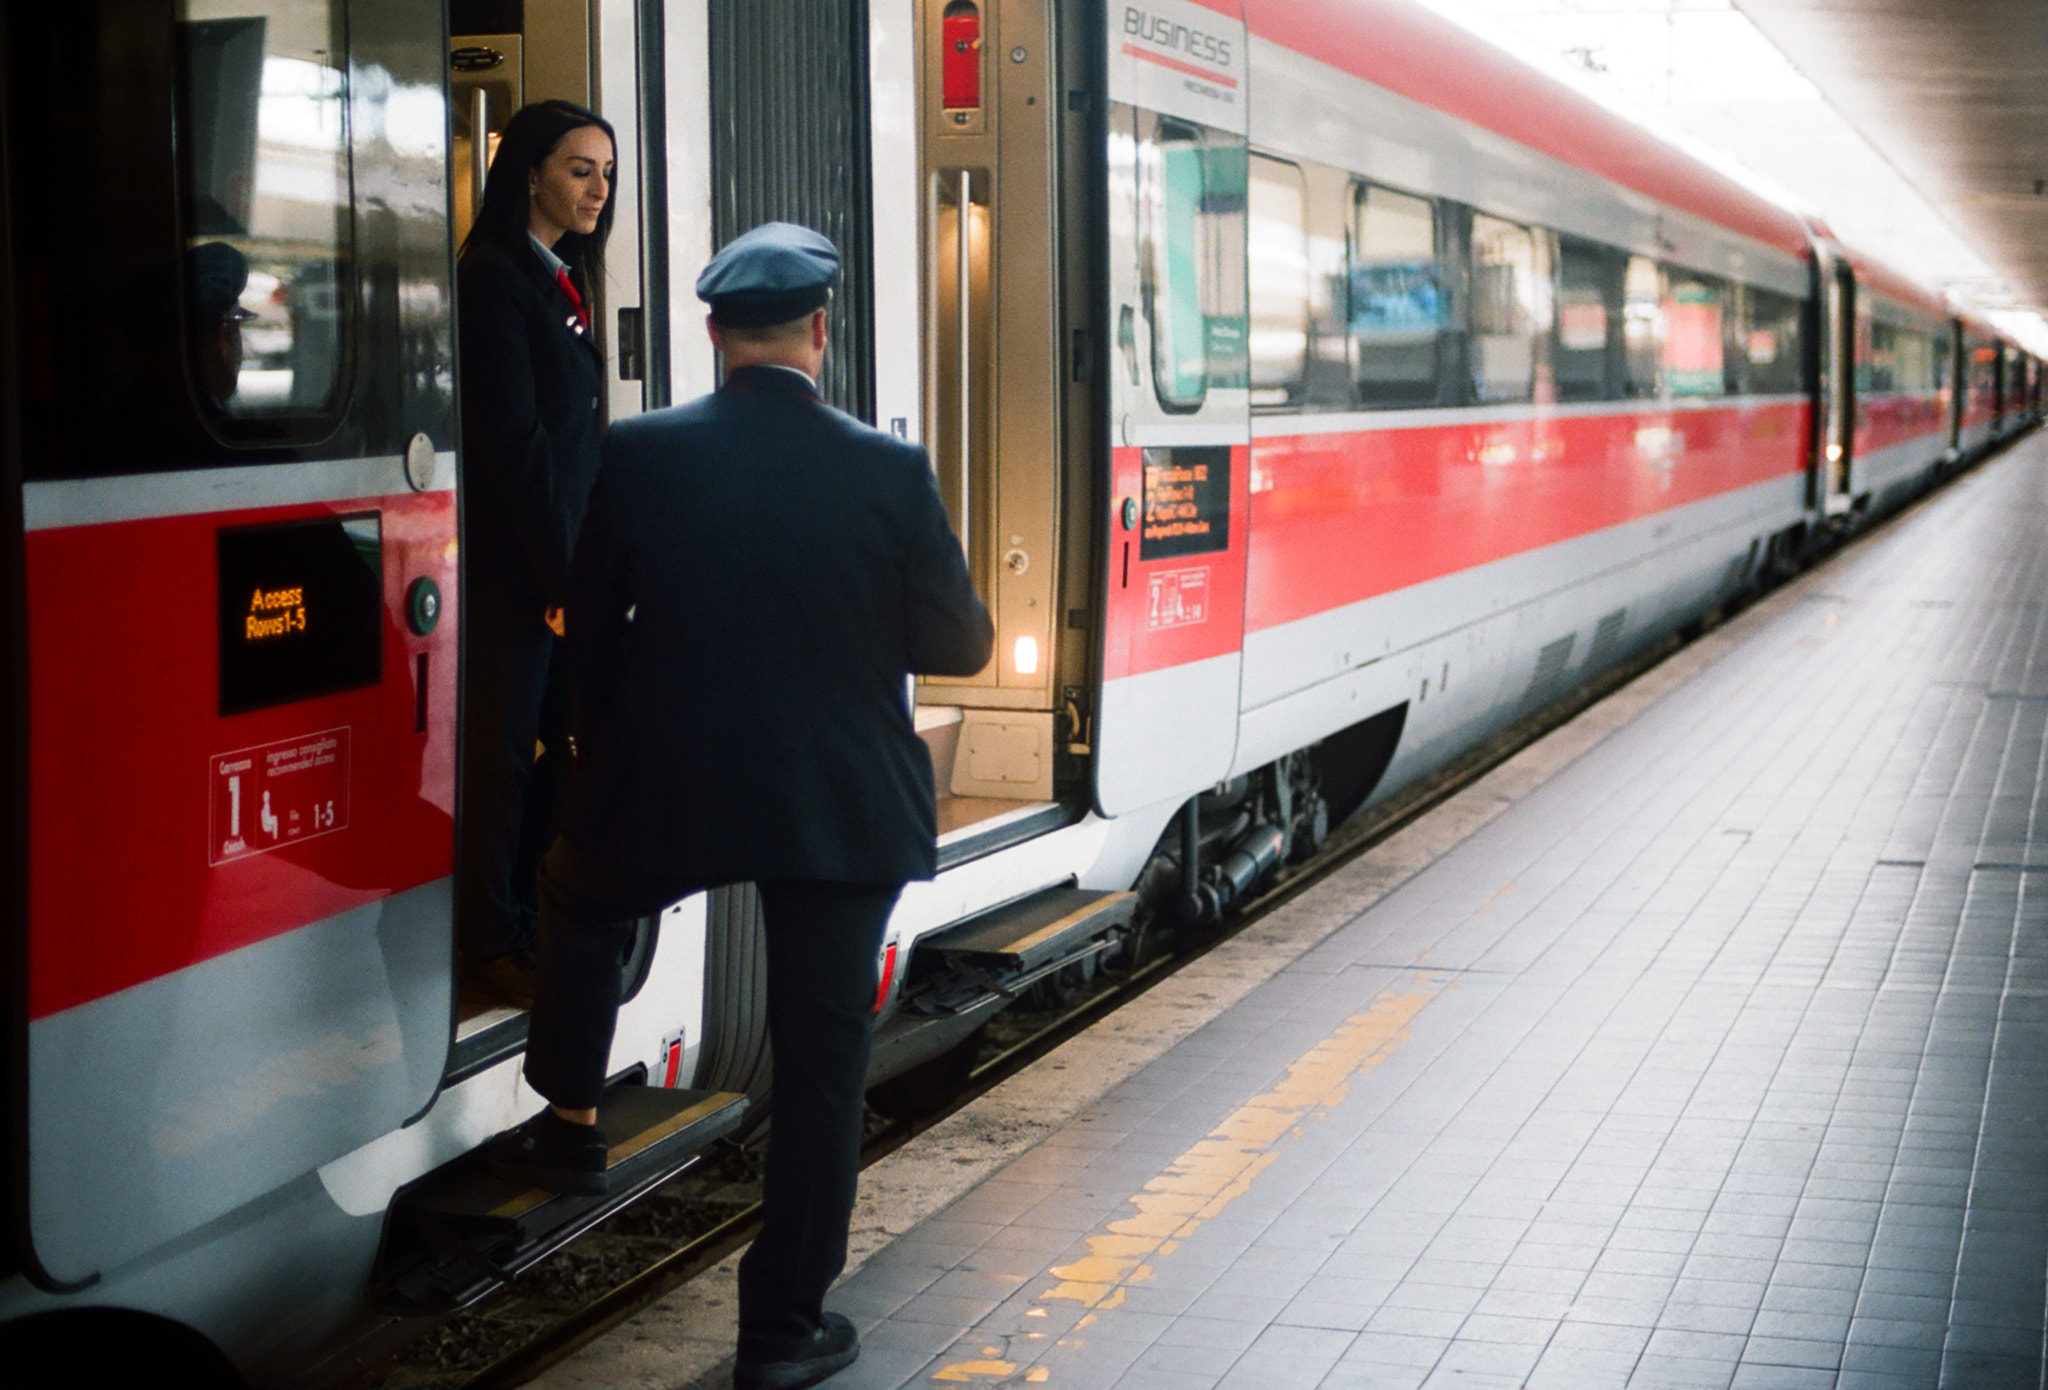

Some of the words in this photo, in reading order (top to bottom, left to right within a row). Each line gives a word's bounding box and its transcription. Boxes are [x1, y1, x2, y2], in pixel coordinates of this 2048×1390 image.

[1124, 6, 1231, 66] BUSINESS
[251, 588, 302, 610] Access
[228, 775, 240, 837] 1
[314, 800, 334, 829] 1-5
